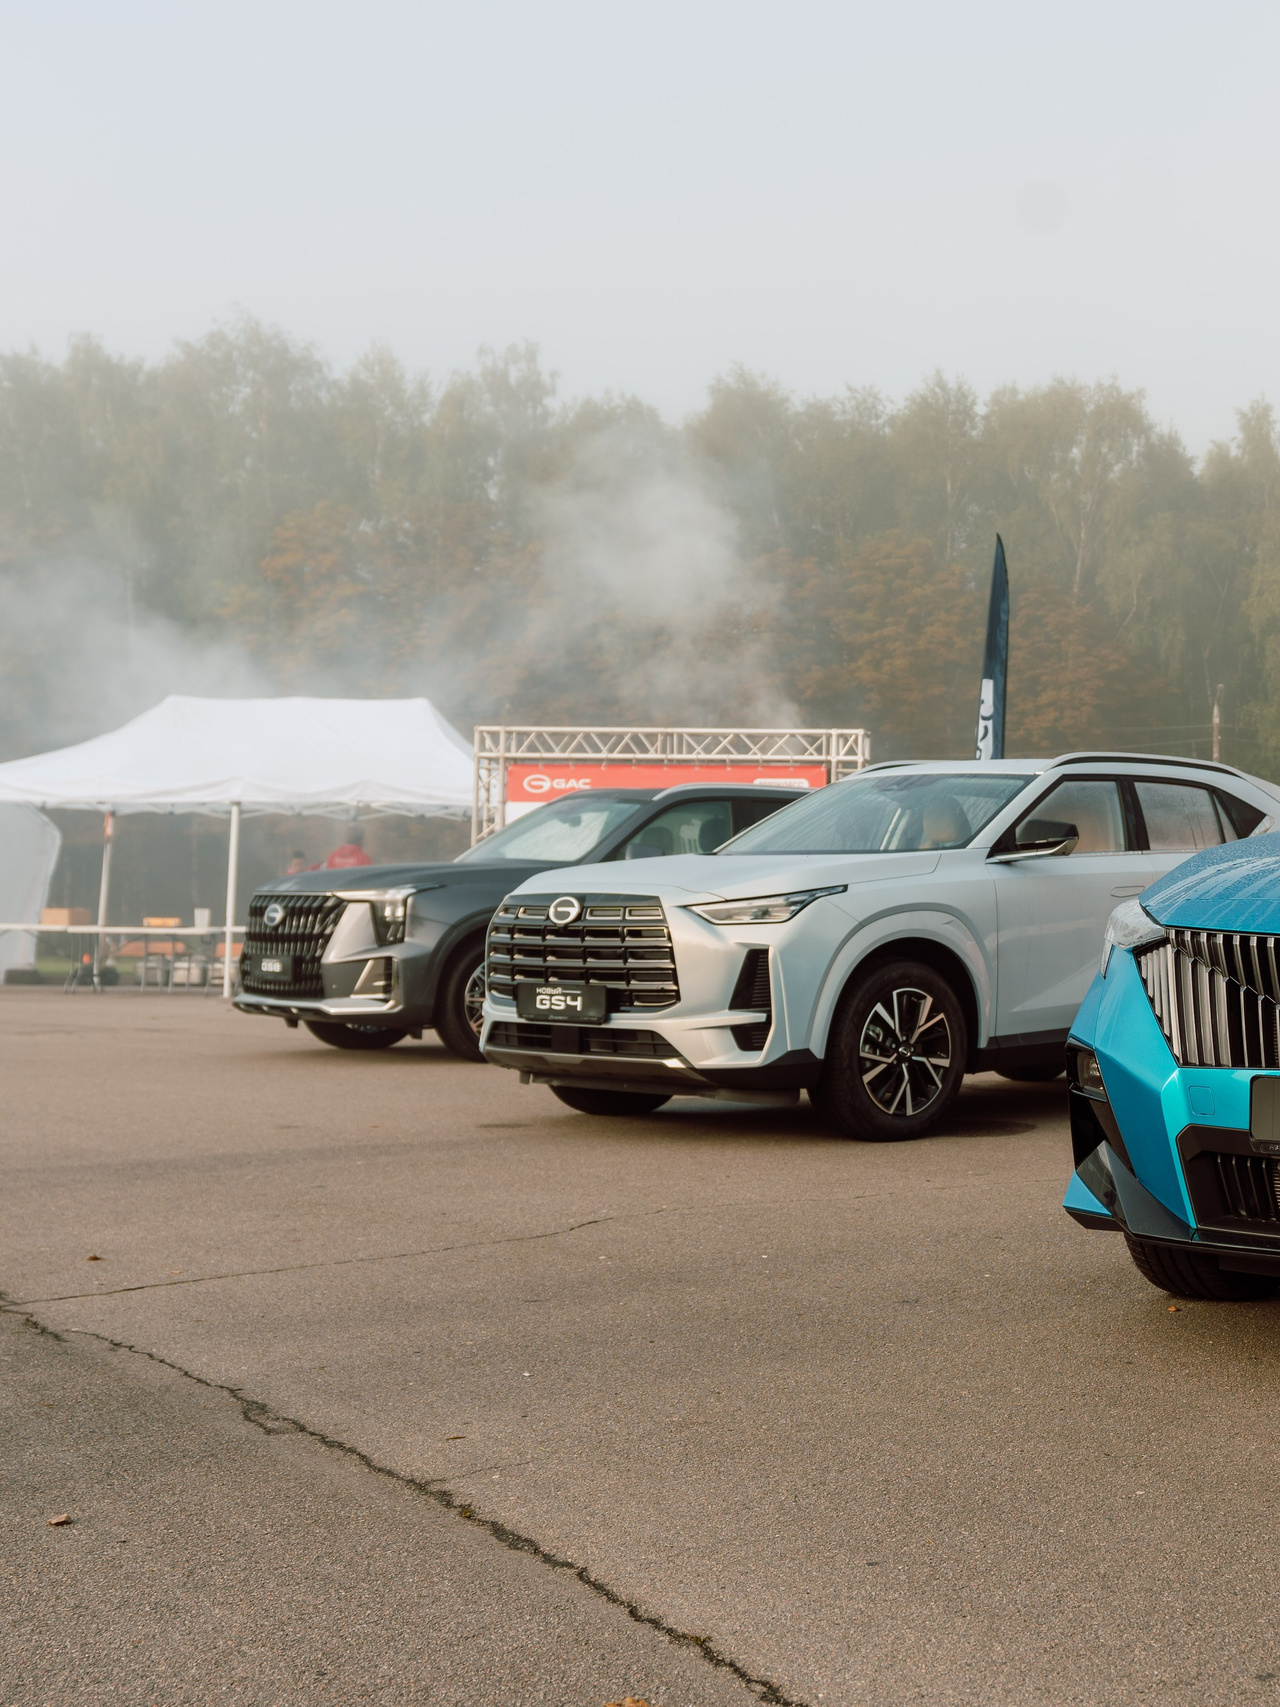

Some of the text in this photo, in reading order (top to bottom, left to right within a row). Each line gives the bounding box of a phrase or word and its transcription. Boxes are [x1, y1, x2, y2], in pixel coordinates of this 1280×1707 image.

[552, 779, 591, 789] GAC
[536, 987, 562, 995] НОВЫЙ
[536, 995, 582, 1012] GS4
